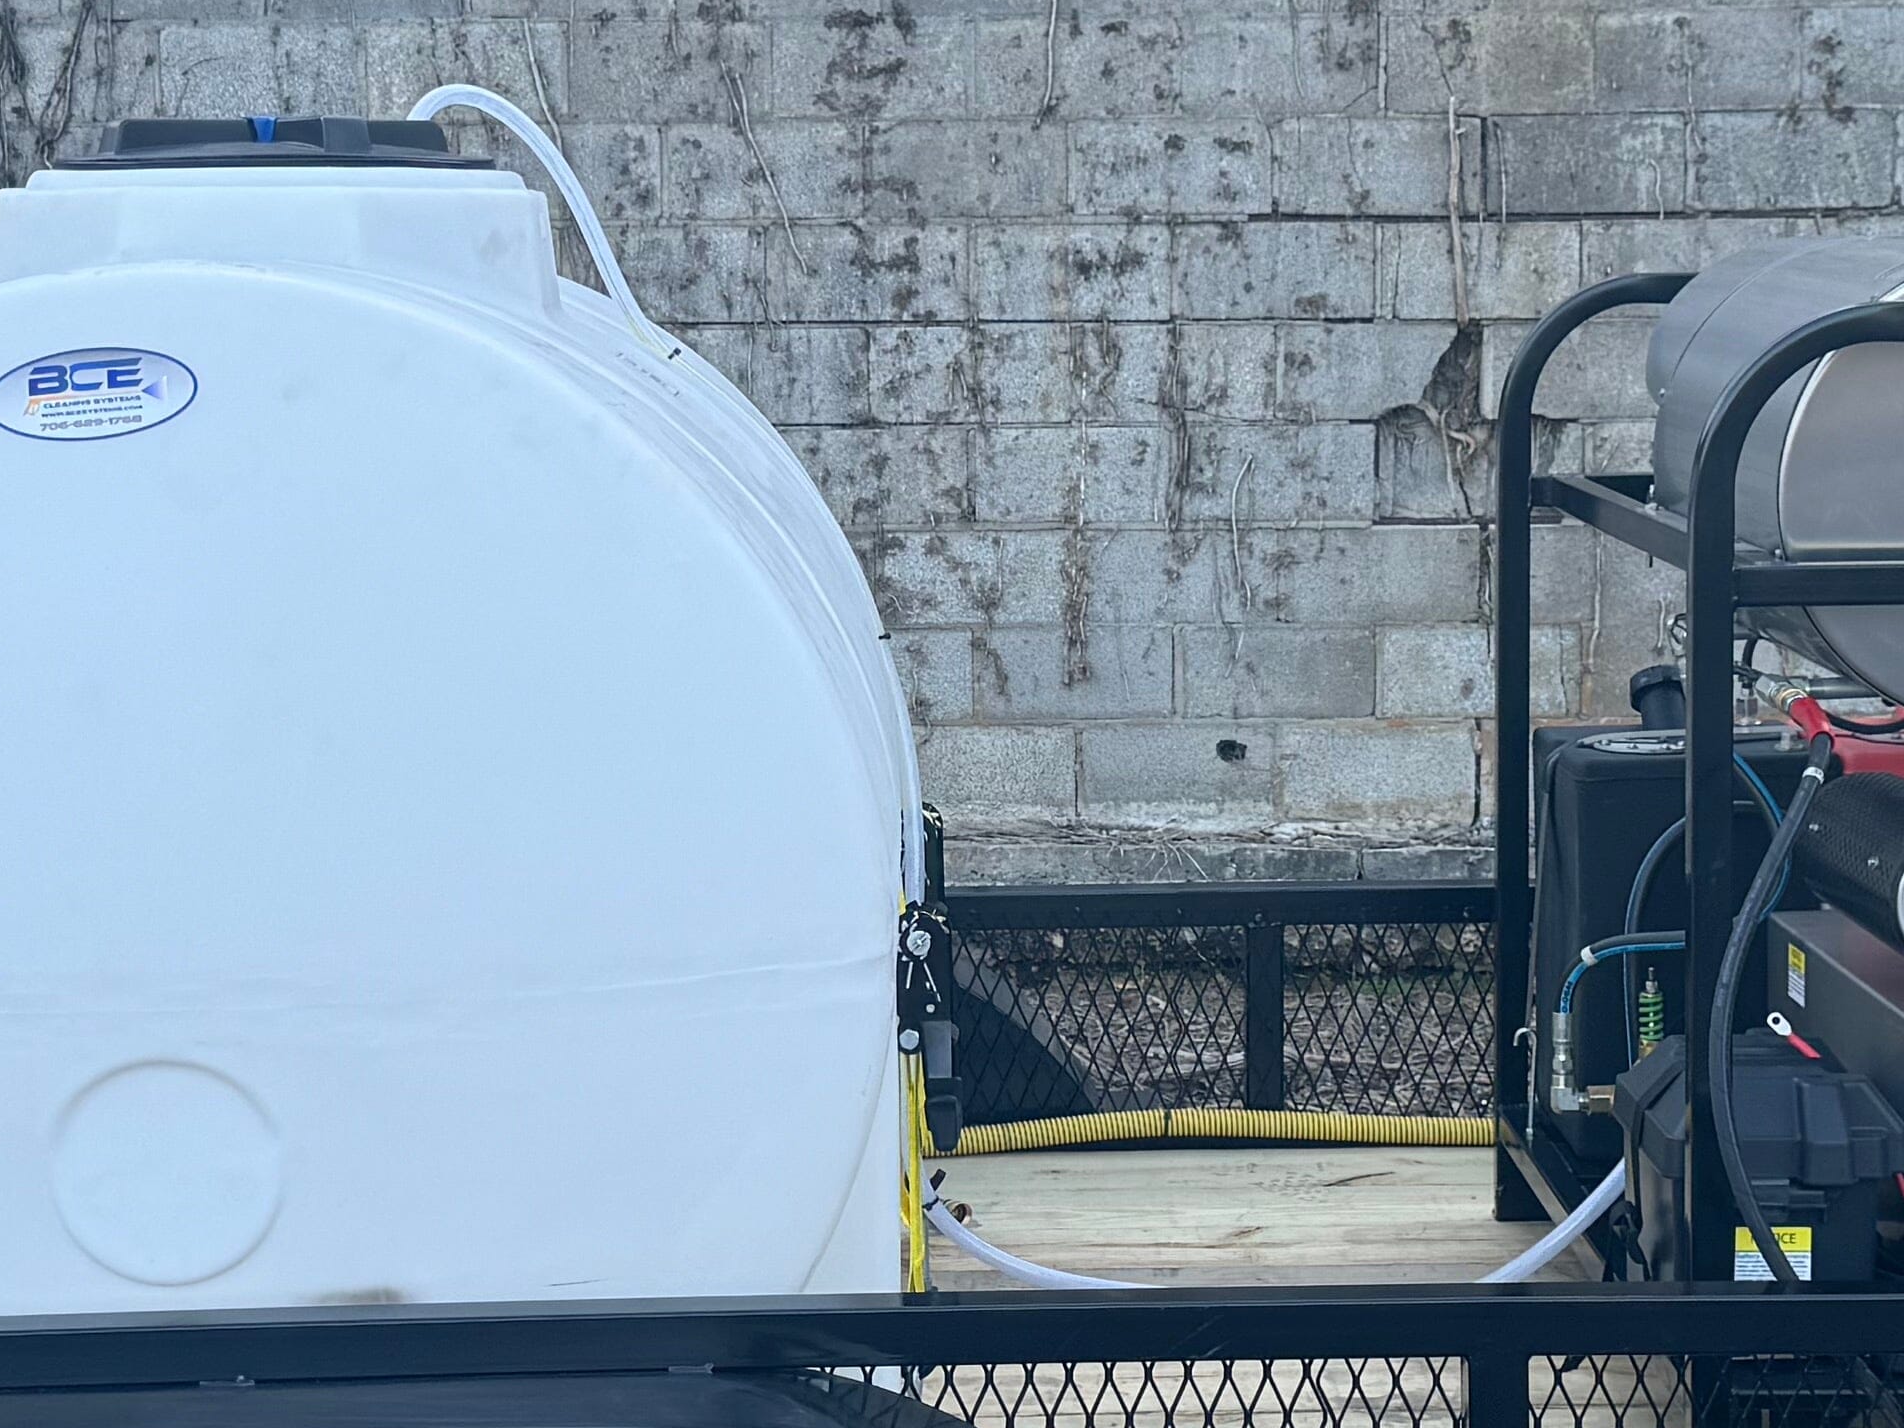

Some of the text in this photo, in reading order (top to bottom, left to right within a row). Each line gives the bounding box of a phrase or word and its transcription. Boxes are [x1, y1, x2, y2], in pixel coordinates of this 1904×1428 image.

[28, 357, 143, 396] BCE
[43, 396, 141, 409] CLEANING SYSTEMS
